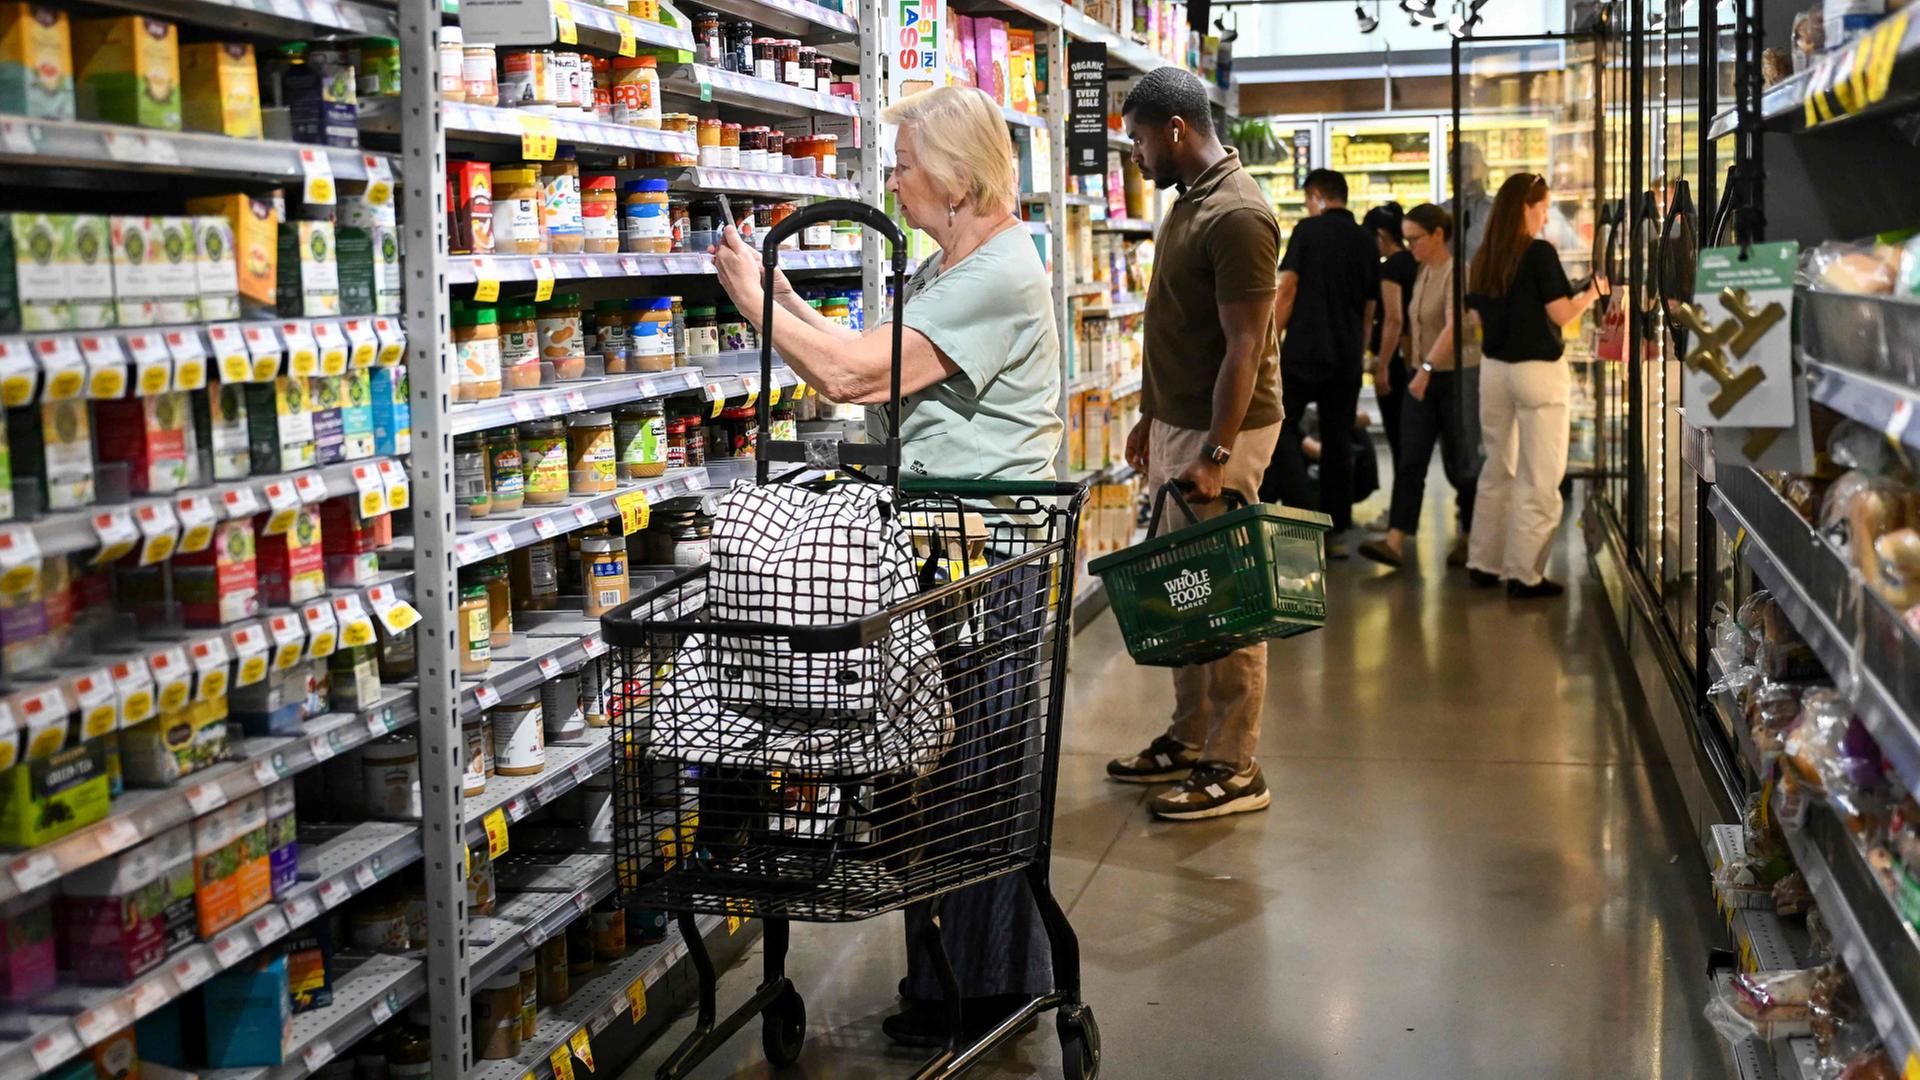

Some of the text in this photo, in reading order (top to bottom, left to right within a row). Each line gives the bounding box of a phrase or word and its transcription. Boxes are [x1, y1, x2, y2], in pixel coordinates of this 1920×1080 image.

[924, 52, 934, 68] IN
[1071, 61, 1104, 71] ORGANIC
[1073, 71, 1102, 80] OPTIONS
[614, 84, 642, 110] PB
[1076, 89, 1100, 98] EVERY
[1077, 98, 1099, 107] AISLE
[910, 465, 927, 476] COLOR
[913, 460, 925, 468] NEW
[1163, 569, 1210, 593] WHOLE
[1169, 582, 1212, 607] FOODS
[1177, 597, 1208, 612] MARKET
[1204, 783, 1226, 798] N
